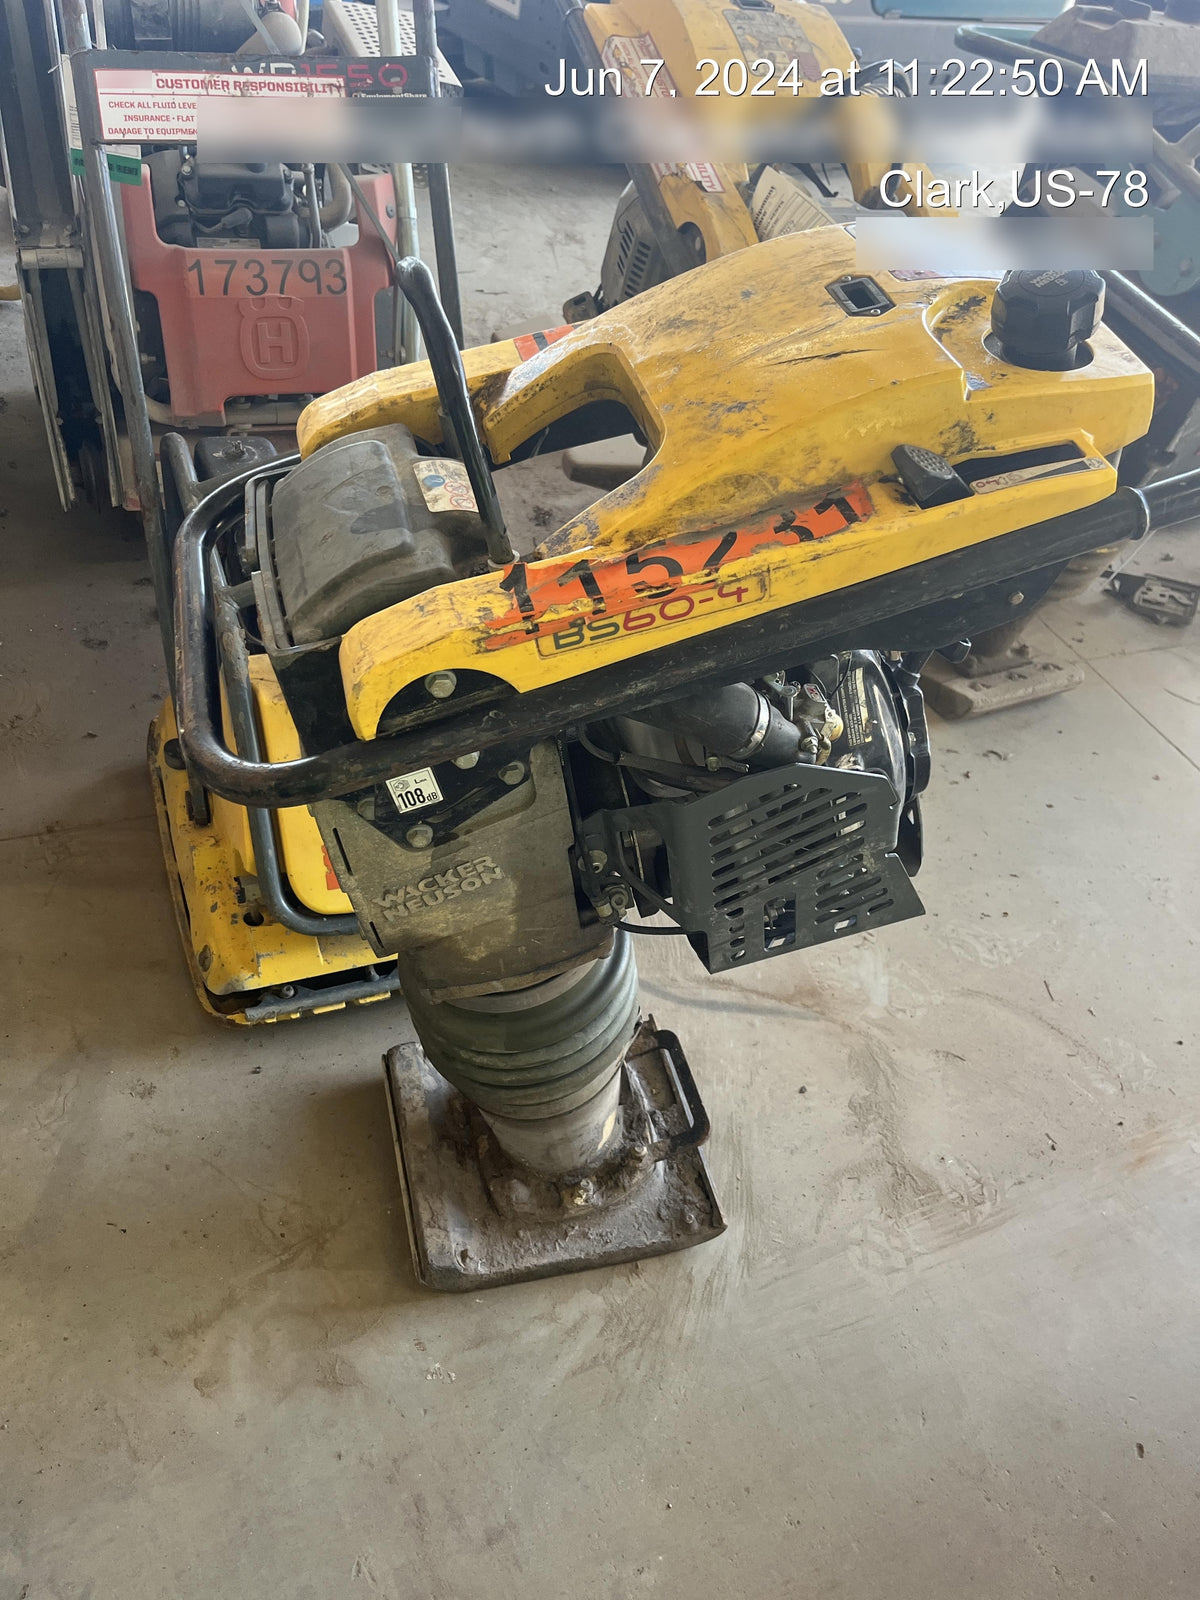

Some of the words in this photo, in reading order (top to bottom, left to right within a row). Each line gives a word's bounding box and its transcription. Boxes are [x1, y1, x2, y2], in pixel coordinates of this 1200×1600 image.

[156, 78, 230, 91] CUSTOMER
[233, 80, 344, 94] RESPONSIBILITY
[108, 101, 136, 109] CHECK
[137, 101, 151, 109] ALL
[152, 102, 177, 110] FLUID
[123, 114, 171, 122] INSURANCE
[108, 127, 142, 135] DAMAGE
[144, 127, 153, 135] TO
[187, 258, 347, 296] 173793
[552, 584, 749, 651] BS60-4
[397, 787, 426, 809] 108
[426, 791, 438, 802] dB
[371, 855, 498, 908] WACKER
[383, 866, 503, 922] NEUSON
